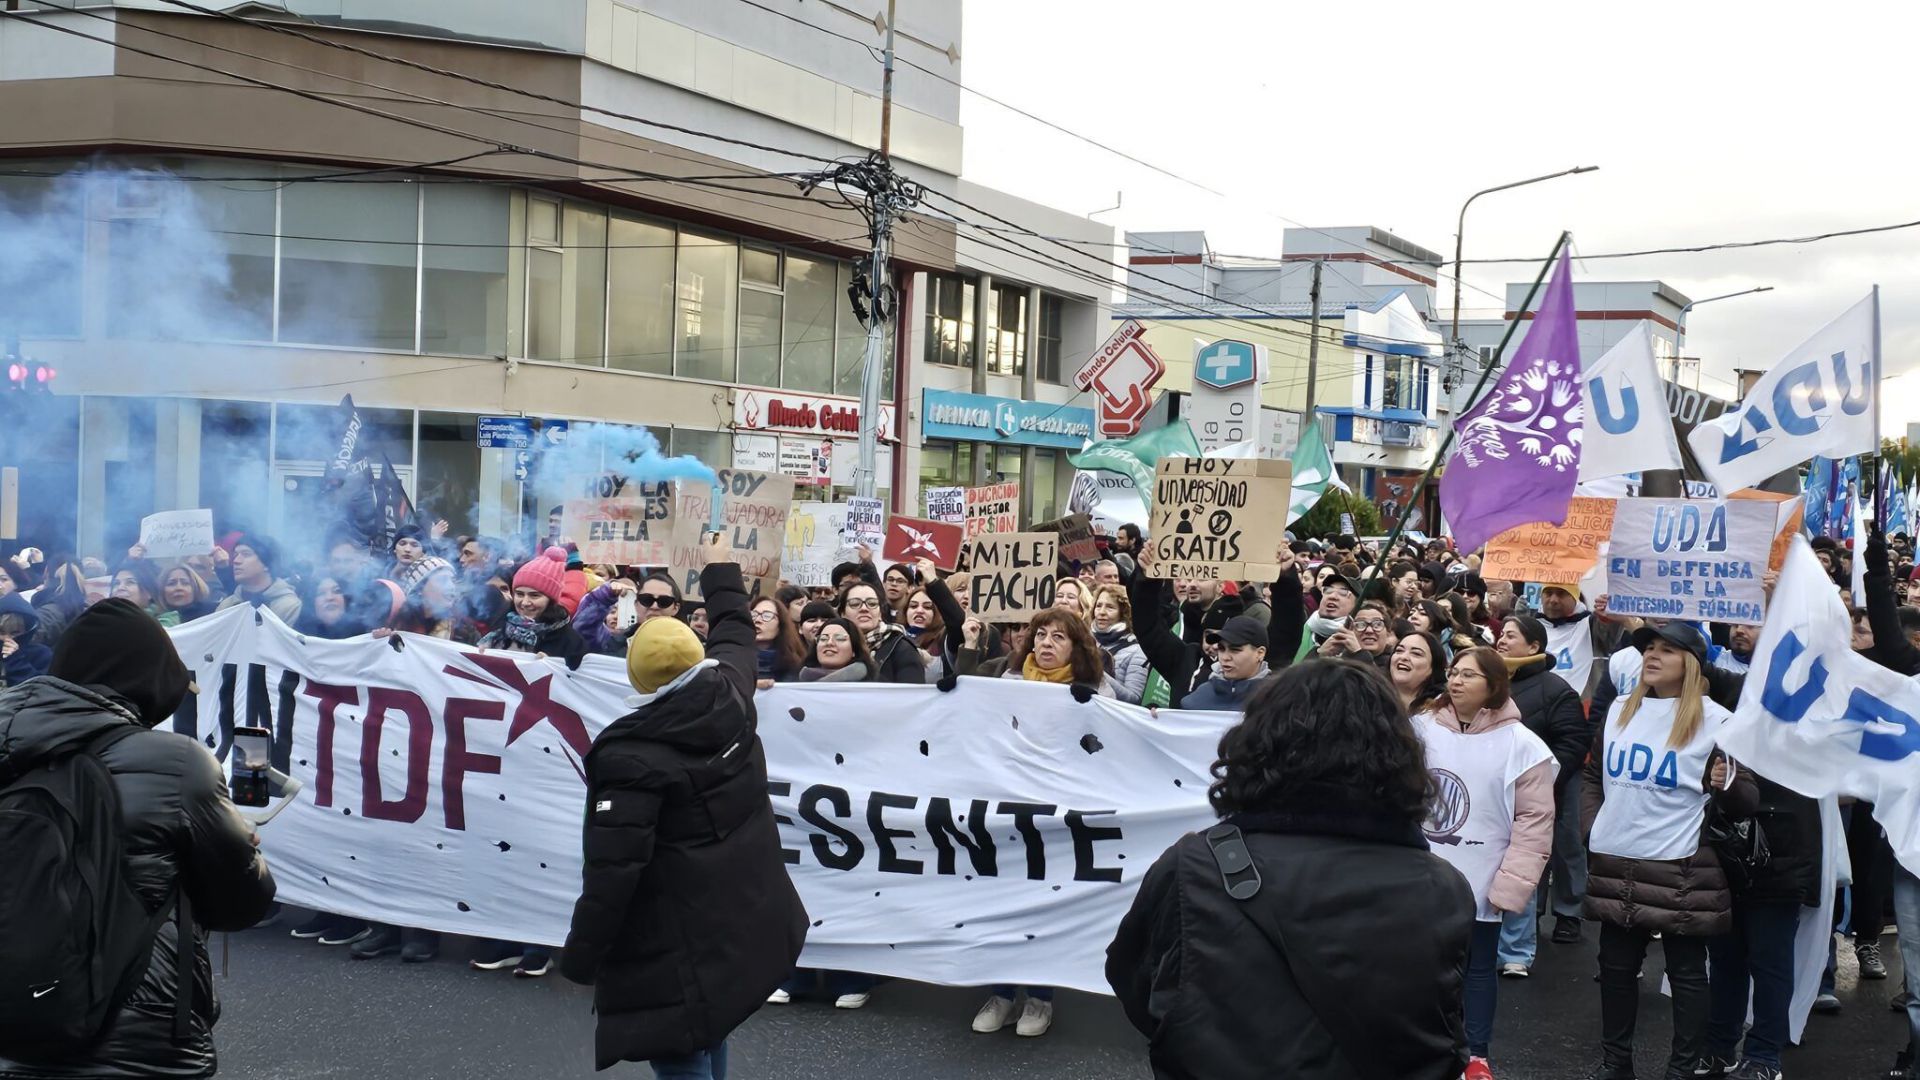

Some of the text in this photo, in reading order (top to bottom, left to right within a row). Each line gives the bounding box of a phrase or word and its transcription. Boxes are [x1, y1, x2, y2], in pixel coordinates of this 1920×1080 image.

[1078, 324, 1136, 385] Mundo Celular
[767, 399, 862, 432] Mundo Celul
[927, 403, 992, 429] FARMACIA
[515, 440, 527, 448] 700
[1184, 458, 1235, 476] HOY
[584, 475, 669, 498] HOY LA
[719, 469, 767, 497] SOY
[1097, 478, 1138, 490] NDIC
[645, 497, 668, 520] ES
[680, 495, 785, 530] TRAAJADORA
[847, 511, 882, 526] PUEBLO
[928, 502, 963, 515] PUEBLO
[979, 501, 1011, 517] MEJOR
[1161, 510, 1172, 528] Y
[589, 520, 650, 541] EN LA
[846, 522, 858, 531] NO
[965, 515, 1016, 537] ER$ION
[1653, 504, 1728, 554] UDA
[732, 526, 758, 550] LA
[1157, 530, 1242, 562] GRATIS
[672, 545, 771, 578] UNIIDAD
[1152, 562, 1220, 579] SIEMPRE
[1611, 557, 1754, 580] EN DEFENSA
[970, 571, 1056, 615] FACHO
[1670, 580, 1727, 597] DE LA
[1607, 595, 1762, 622] UNIVERSIDAD PÚBLICA
[1760, 629, 1920, 762] UD
[1606, 741, 1678, 789] UDA
[767, 783, 1123, 883] ESENTE
